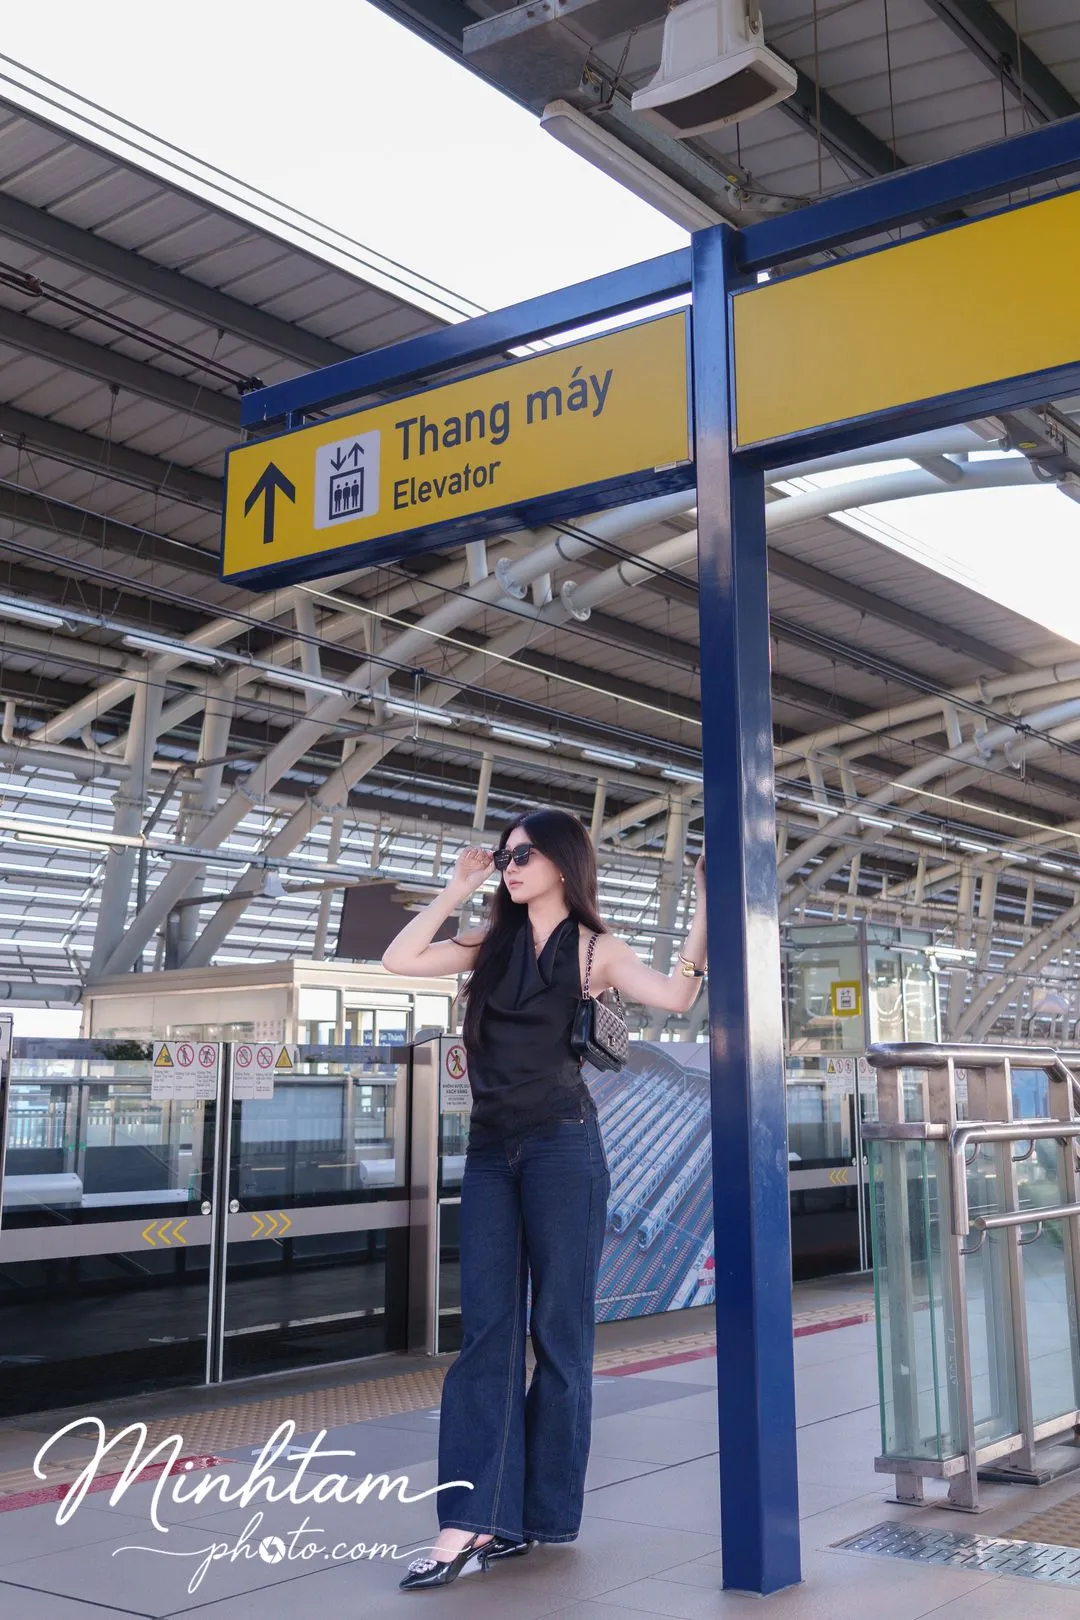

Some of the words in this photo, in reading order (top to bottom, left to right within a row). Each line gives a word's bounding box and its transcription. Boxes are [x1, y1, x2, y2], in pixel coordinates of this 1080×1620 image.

[394, 401, 510, 461] Thang
[526, 365, 613, 425] máy
[393, 461, 502, 511] Elevator
